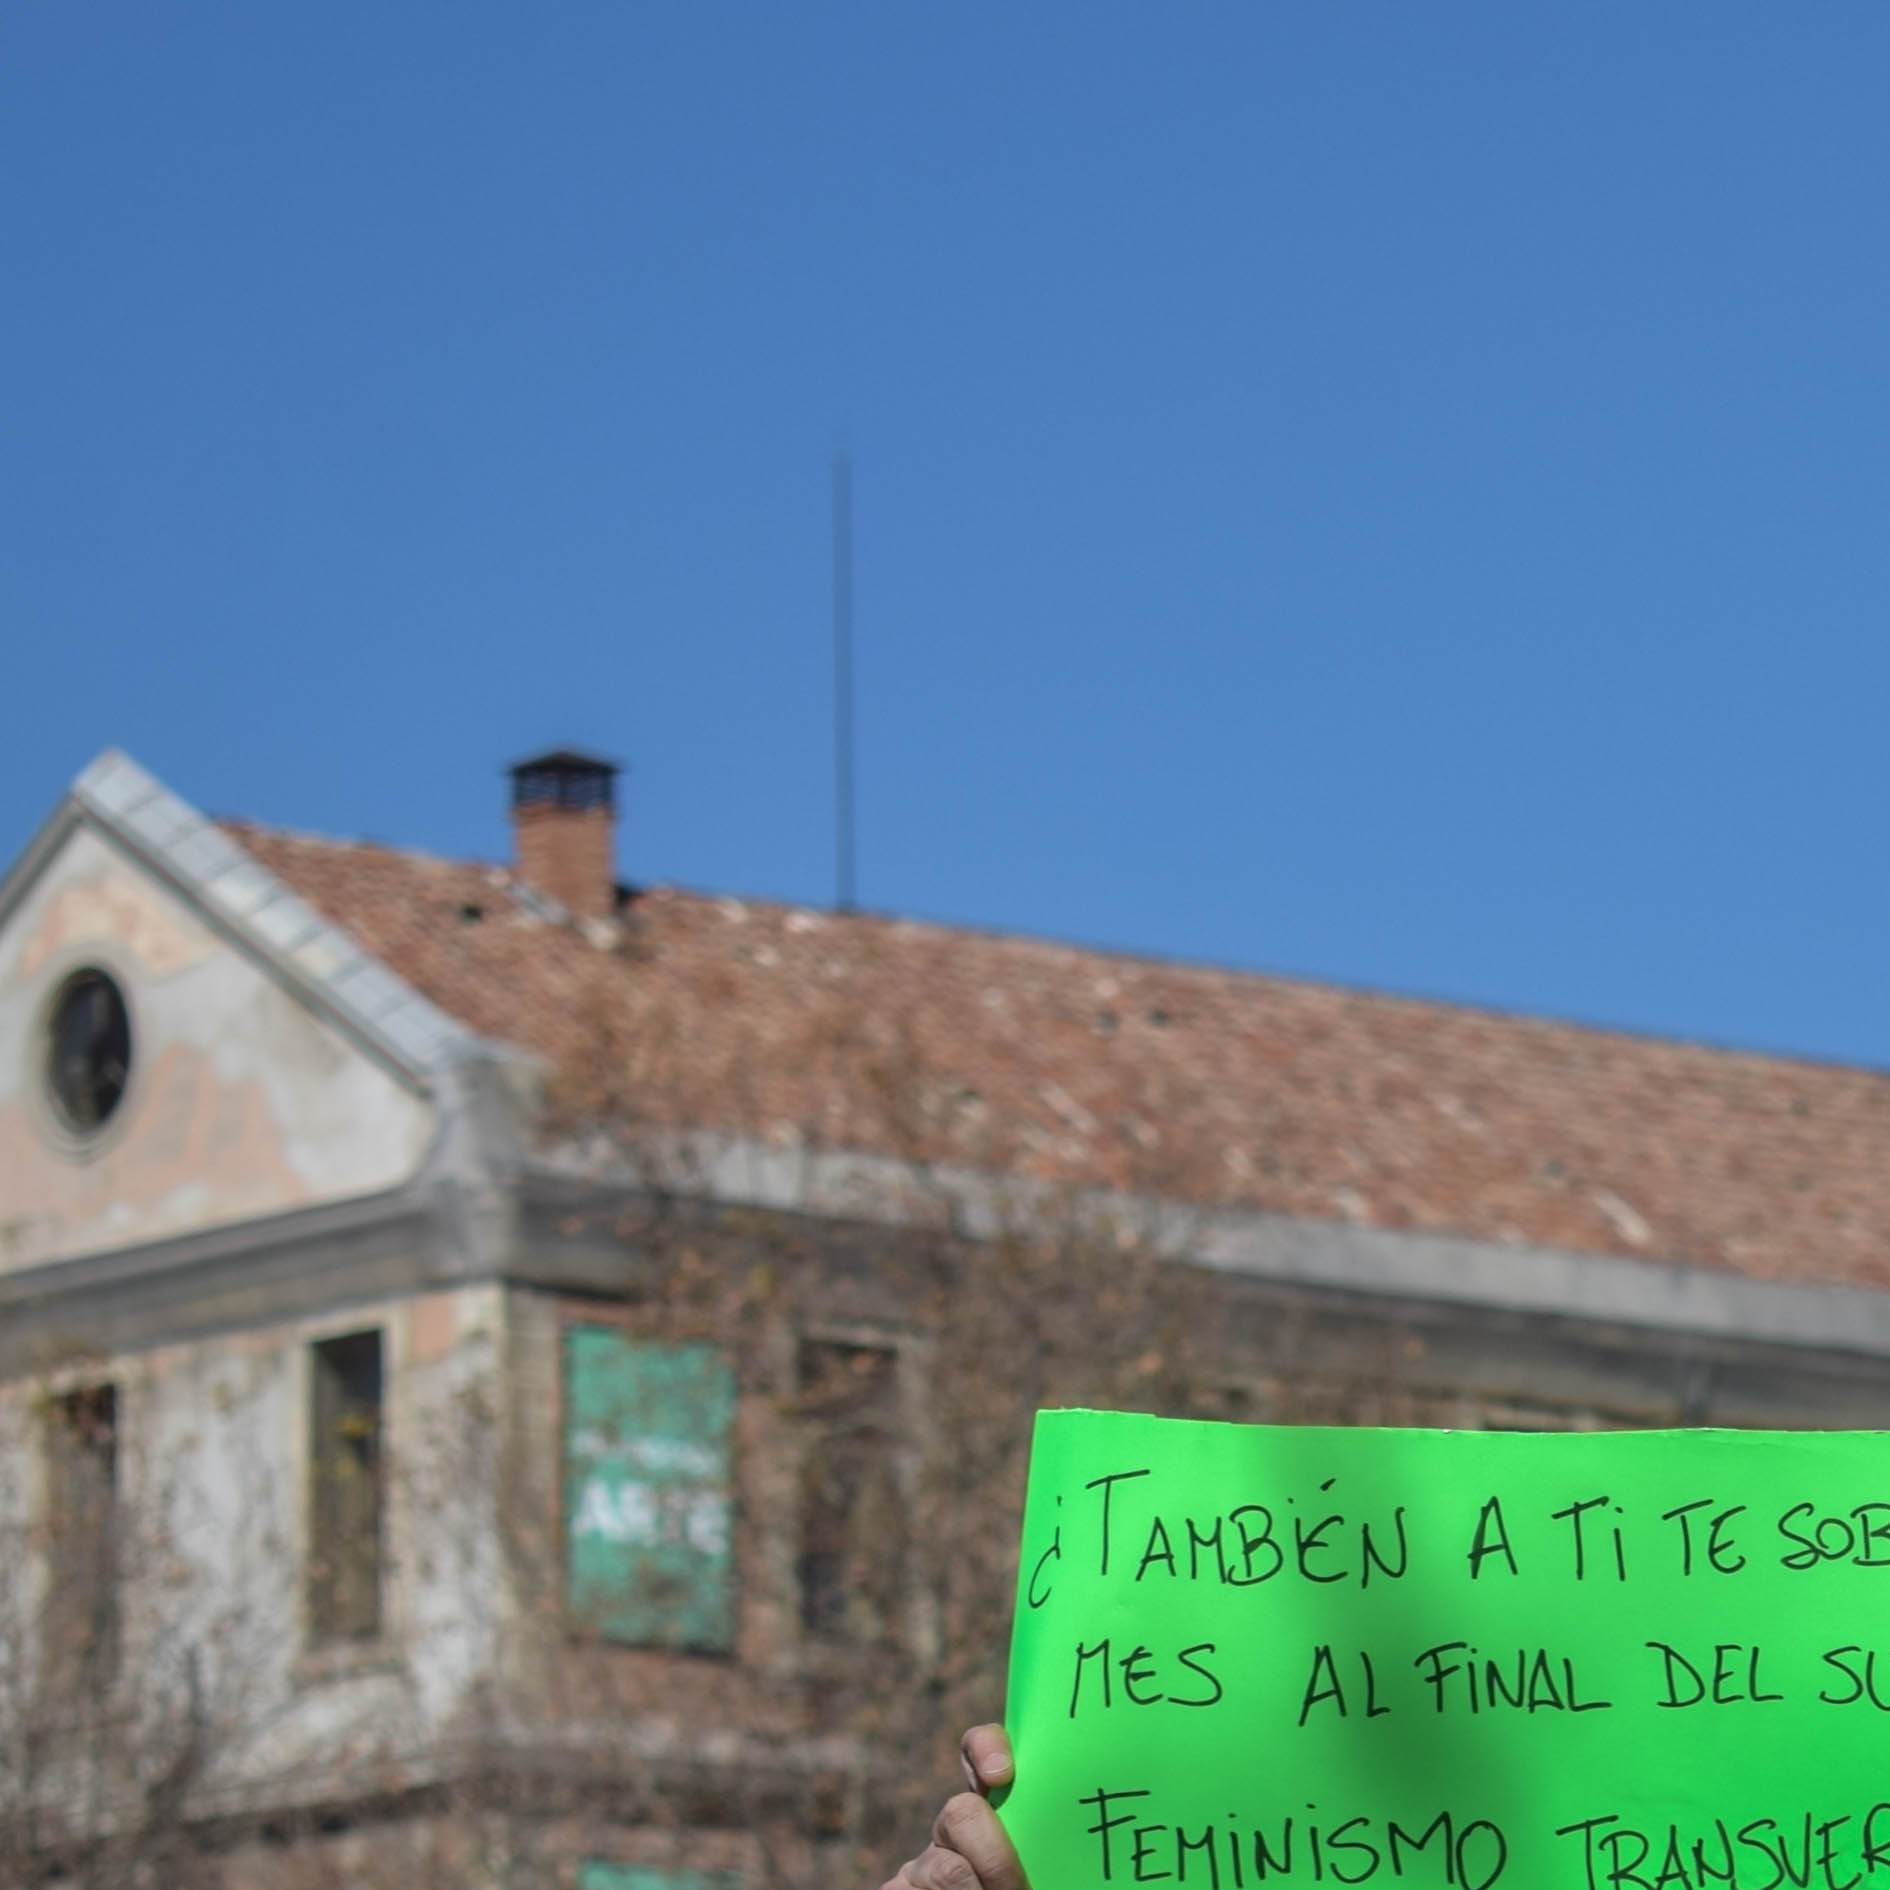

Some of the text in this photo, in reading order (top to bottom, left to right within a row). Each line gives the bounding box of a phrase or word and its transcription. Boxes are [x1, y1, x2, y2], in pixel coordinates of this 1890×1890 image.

[1468, 1496, 1518, 1580] A
[1662, 1499, 1747, 1576] TE
[1070, 1638, 1223, 1719] MES
[1299, 1645, 1391, 1727] AL
[1646, 1641, 1783, 1708] DEL
